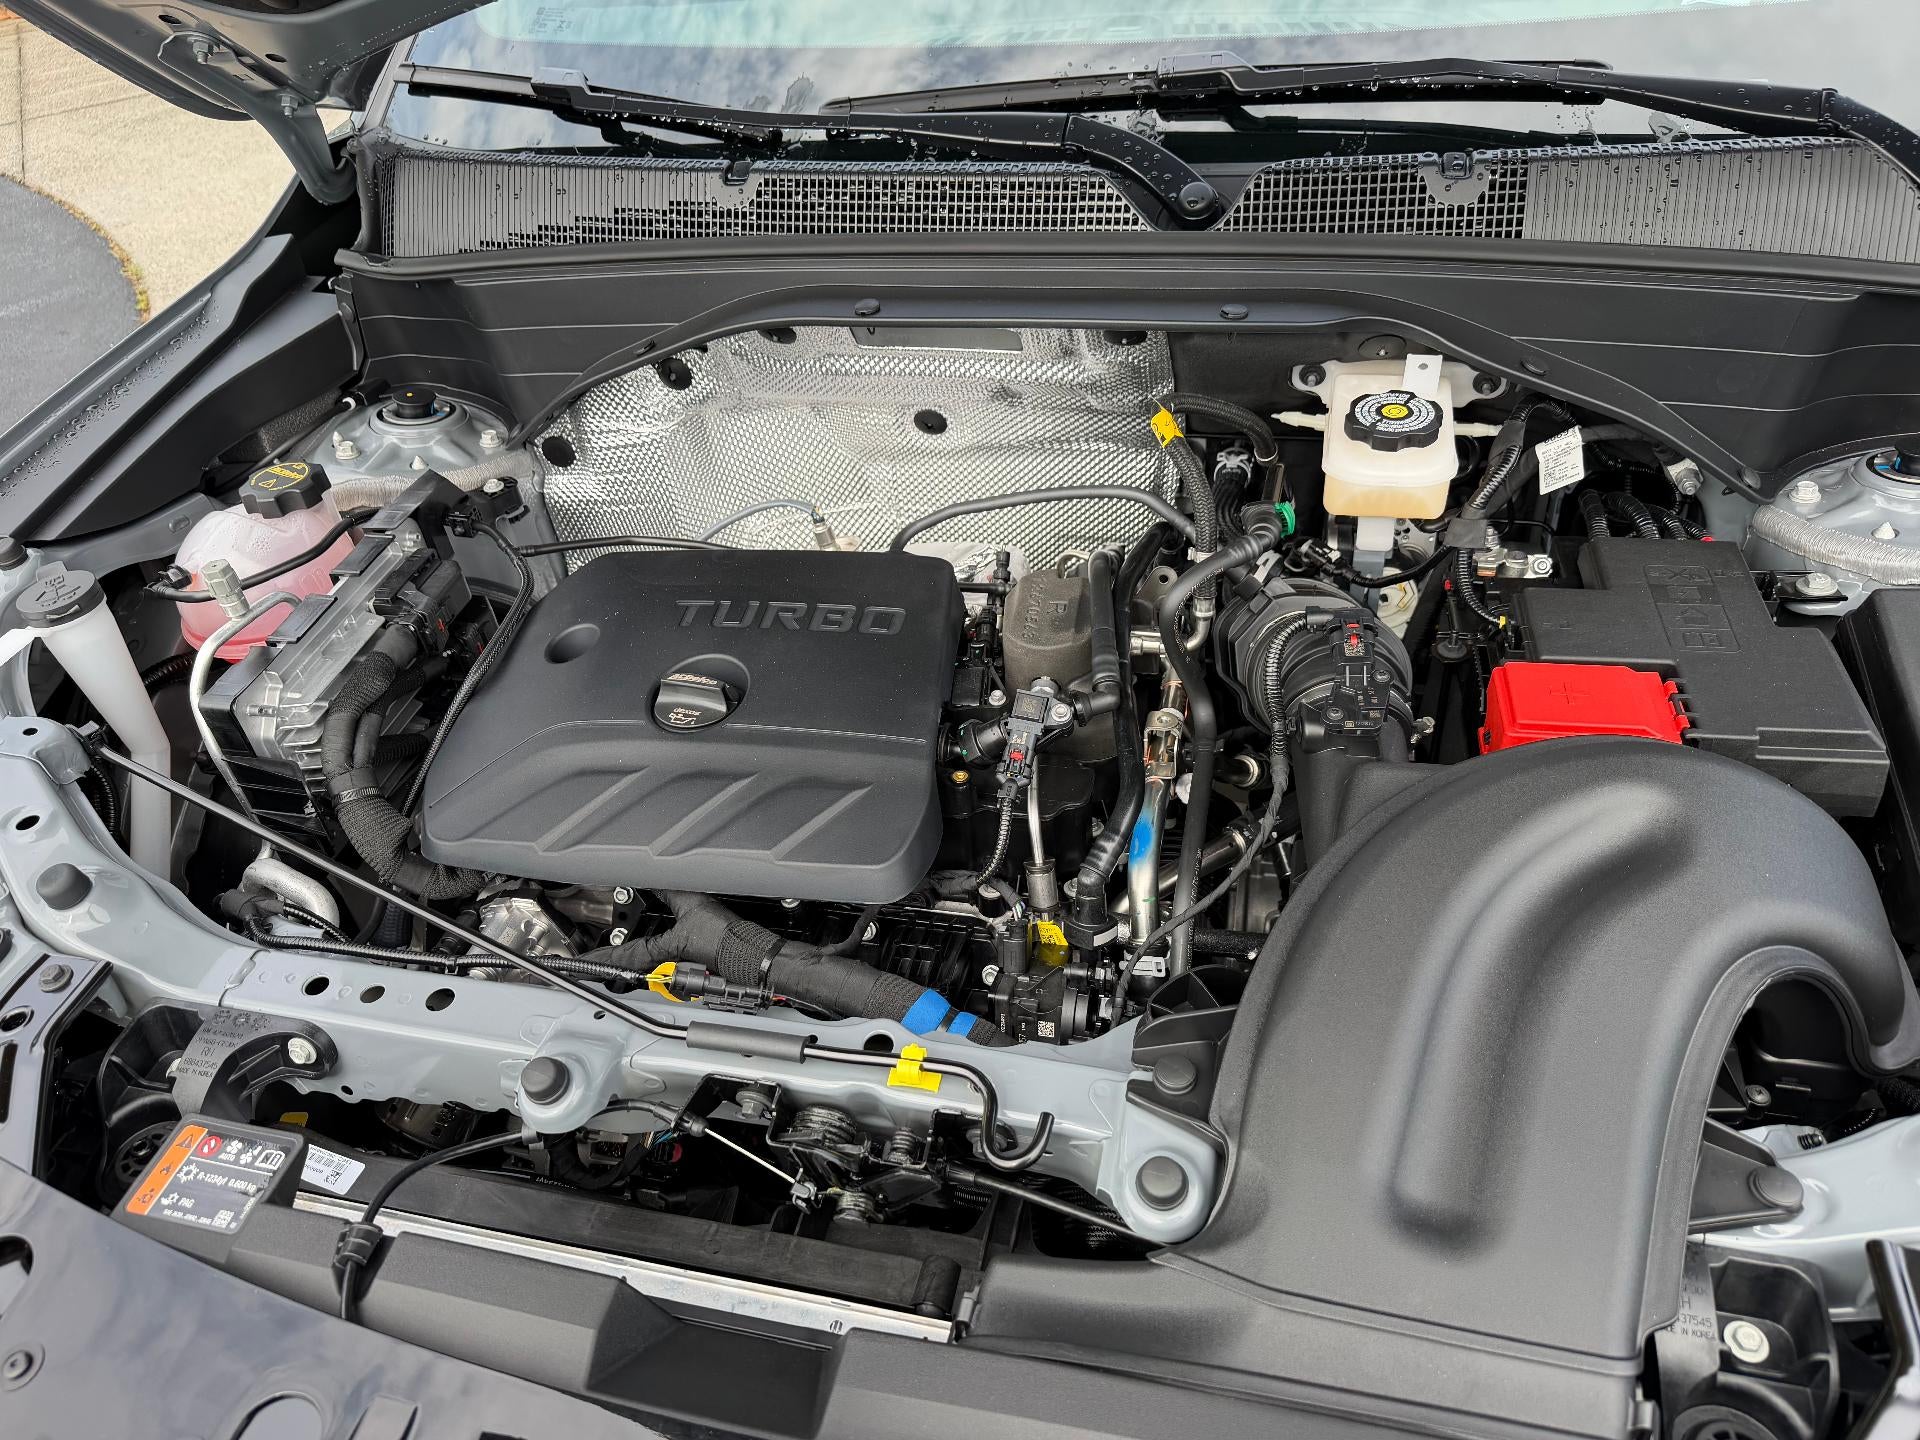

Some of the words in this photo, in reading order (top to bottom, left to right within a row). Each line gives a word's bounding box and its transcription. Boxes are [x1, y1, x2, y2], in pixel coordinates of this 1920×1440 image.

[675, 600, 906, 635] TURBO
[218, 1152, 235, 1161] AUTO
[178, 1197, 195, 1208] PAG
